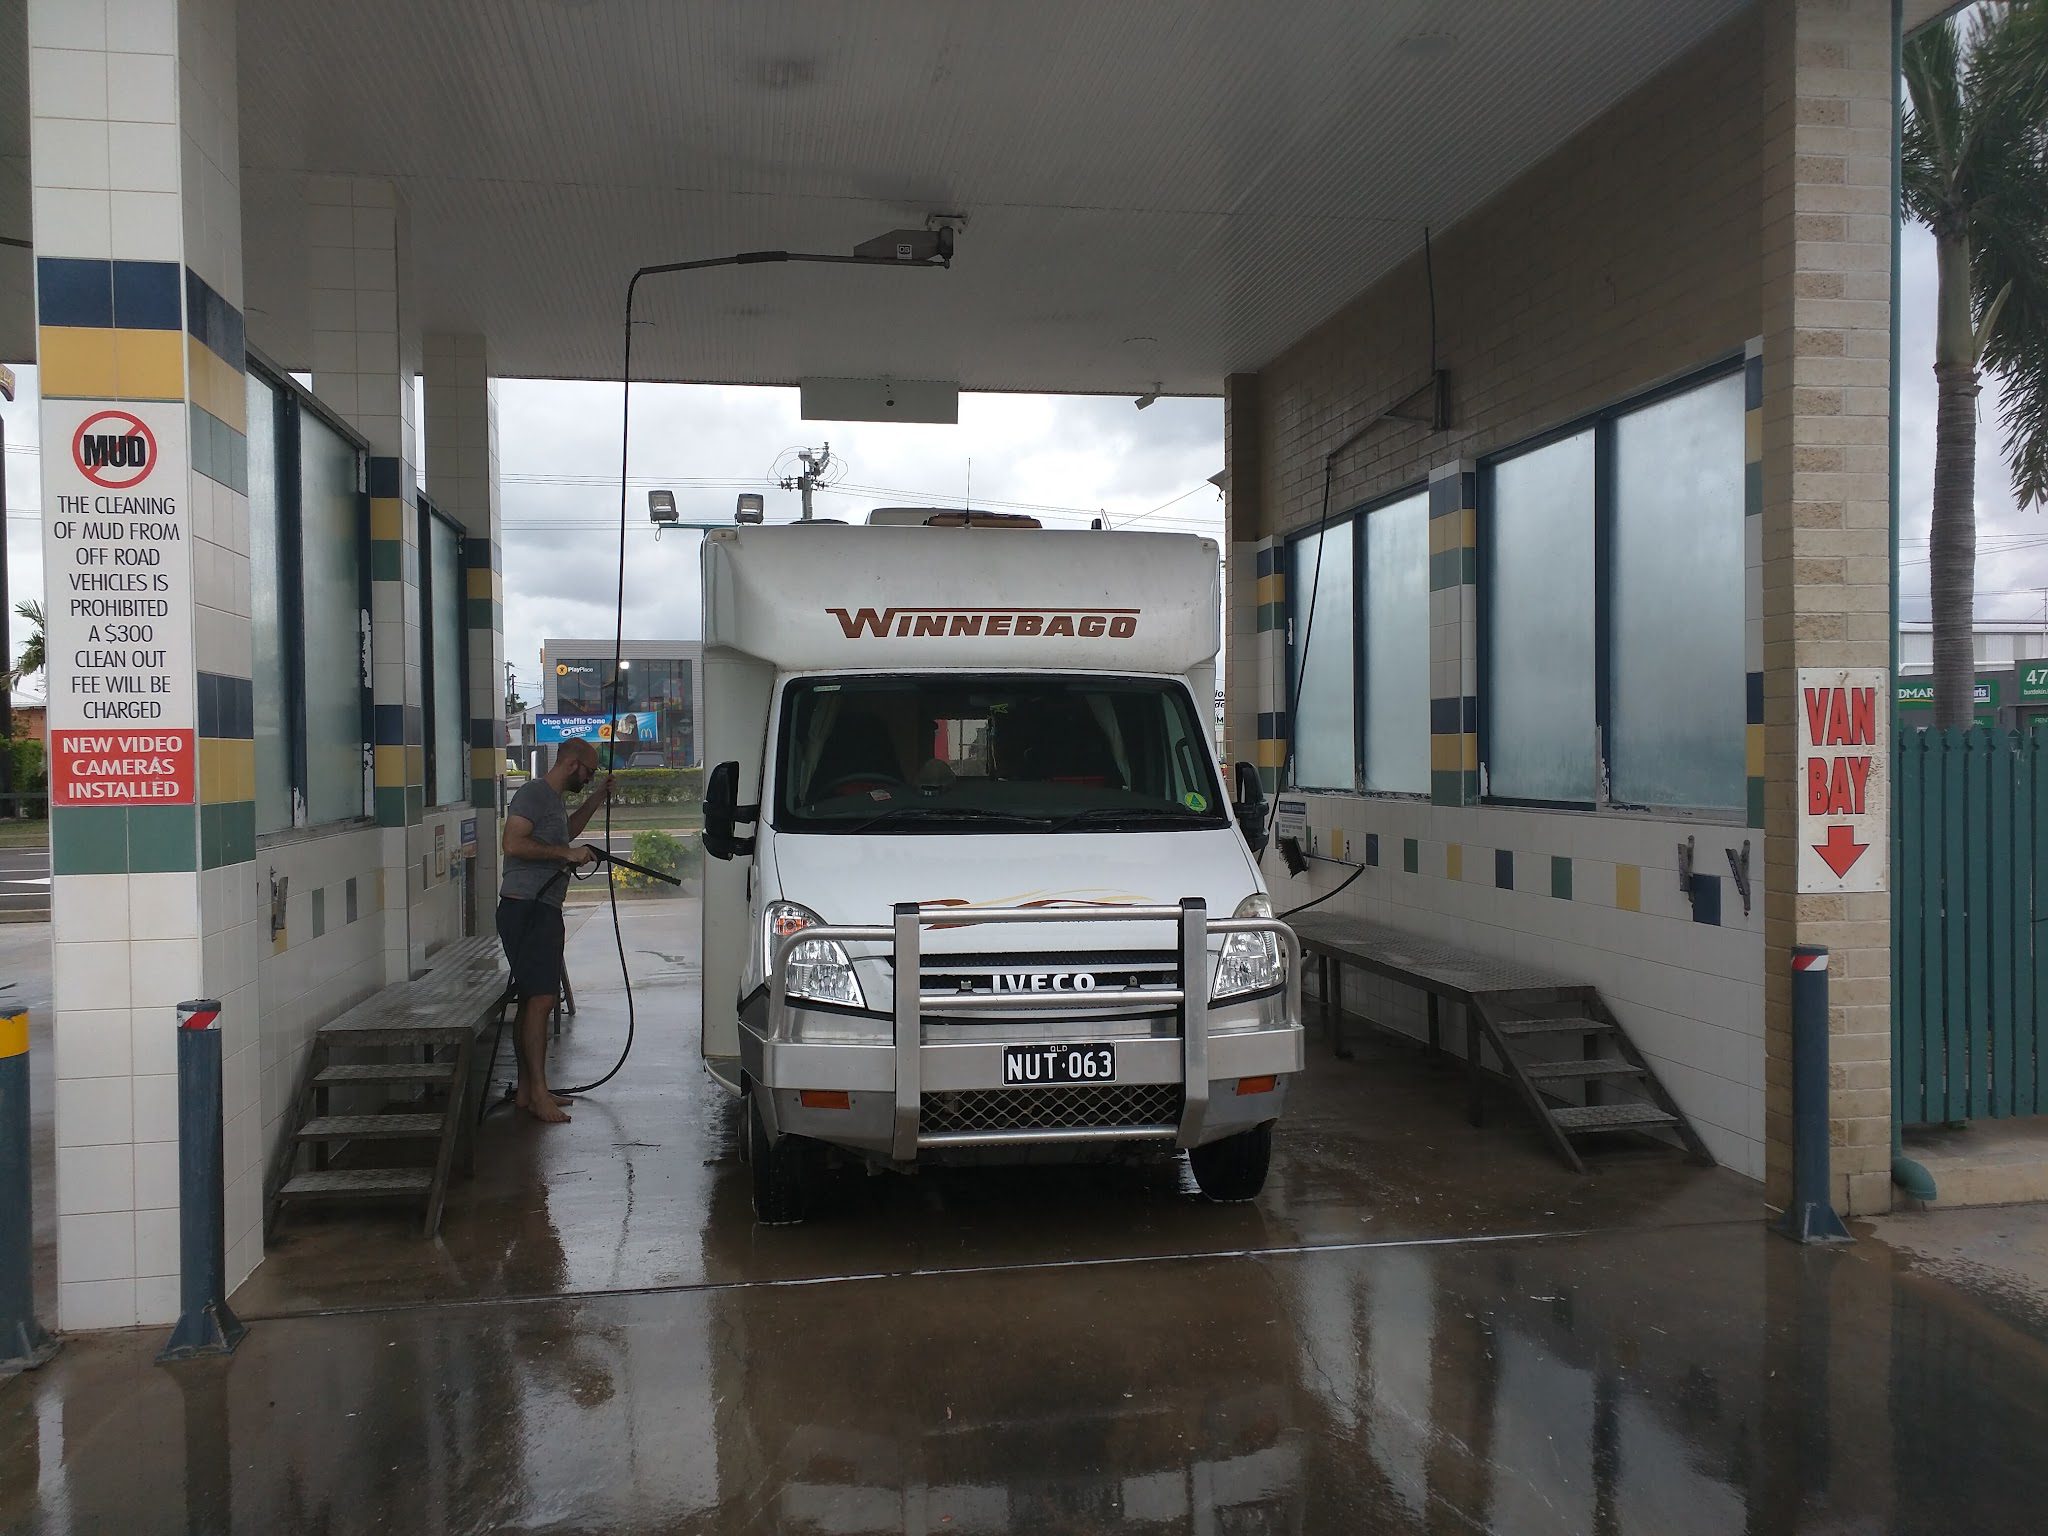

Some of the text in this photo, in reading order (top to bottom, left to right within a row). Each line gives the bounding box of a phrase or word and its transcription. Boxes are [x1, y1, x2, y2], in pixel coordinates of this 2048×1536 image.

[84, 434, 146, 468] MUD
[57, 496, 175, 515] THE CLEANING
[54, 522, 180, 540] OF MUD FROM
[76, 548, 160, 566] OFF ROAD
[69, 573, 168, 592] VEHICLES IS
[71, 599, 168, 617] PROHIBITED
[825, 608, 1141, 639] WINNEBAGO
[89, 624, 153, 644] A $300
[75, 650, 166, 668] CLEAN OUT
[72, 676, 170, 693] FEE WILL BE
[83, 701, 161, 719] CHARGED
[1804, 687, 1876, 746] VAN
[63, 736, 182, 754] NEW VIDEO
[72, 758, 175, 776] CAMERAS
[69, 782, 180, 798] INSTALLED
[1808, 756, 1872, 816] BAY
[992, 974, 1096, 994] IVECO
